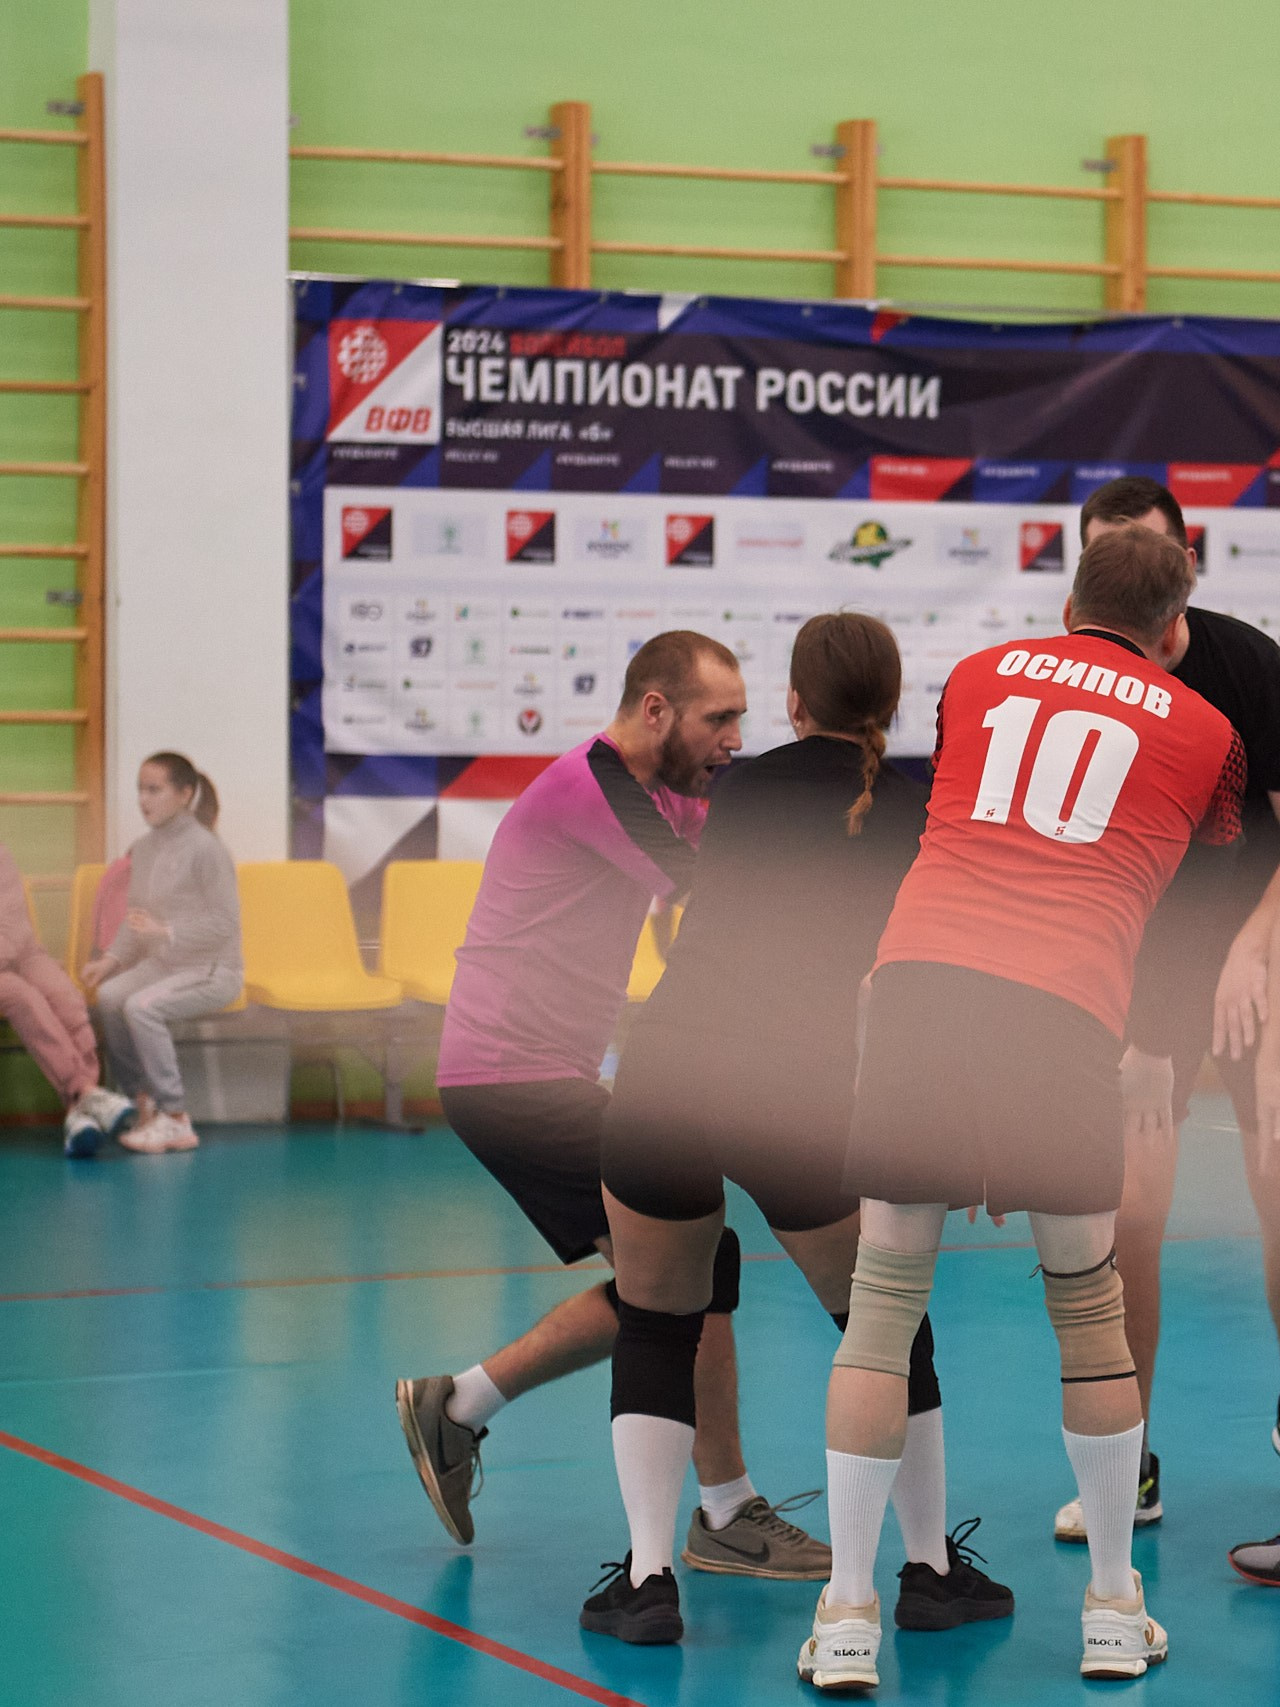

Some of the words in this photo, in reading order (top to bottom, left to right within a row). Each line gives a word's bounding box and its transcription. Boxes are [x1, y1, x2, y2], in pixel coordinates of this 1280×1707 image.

[448, 330, 505, 353] 2024
[445, 356, 744, 411] ЧЕМПИОНАТ
[755, 368, 941, 419] РОССИИ
[364, 406, 432, 434] ВФВ
[445, 418, 525, 439] ВЫСШАЯ
[527, 420, 572, 441] ЛИГА
[996, 649, 1173, 720] ОСИПОВ
[970, 695, 1140, 844] 10
